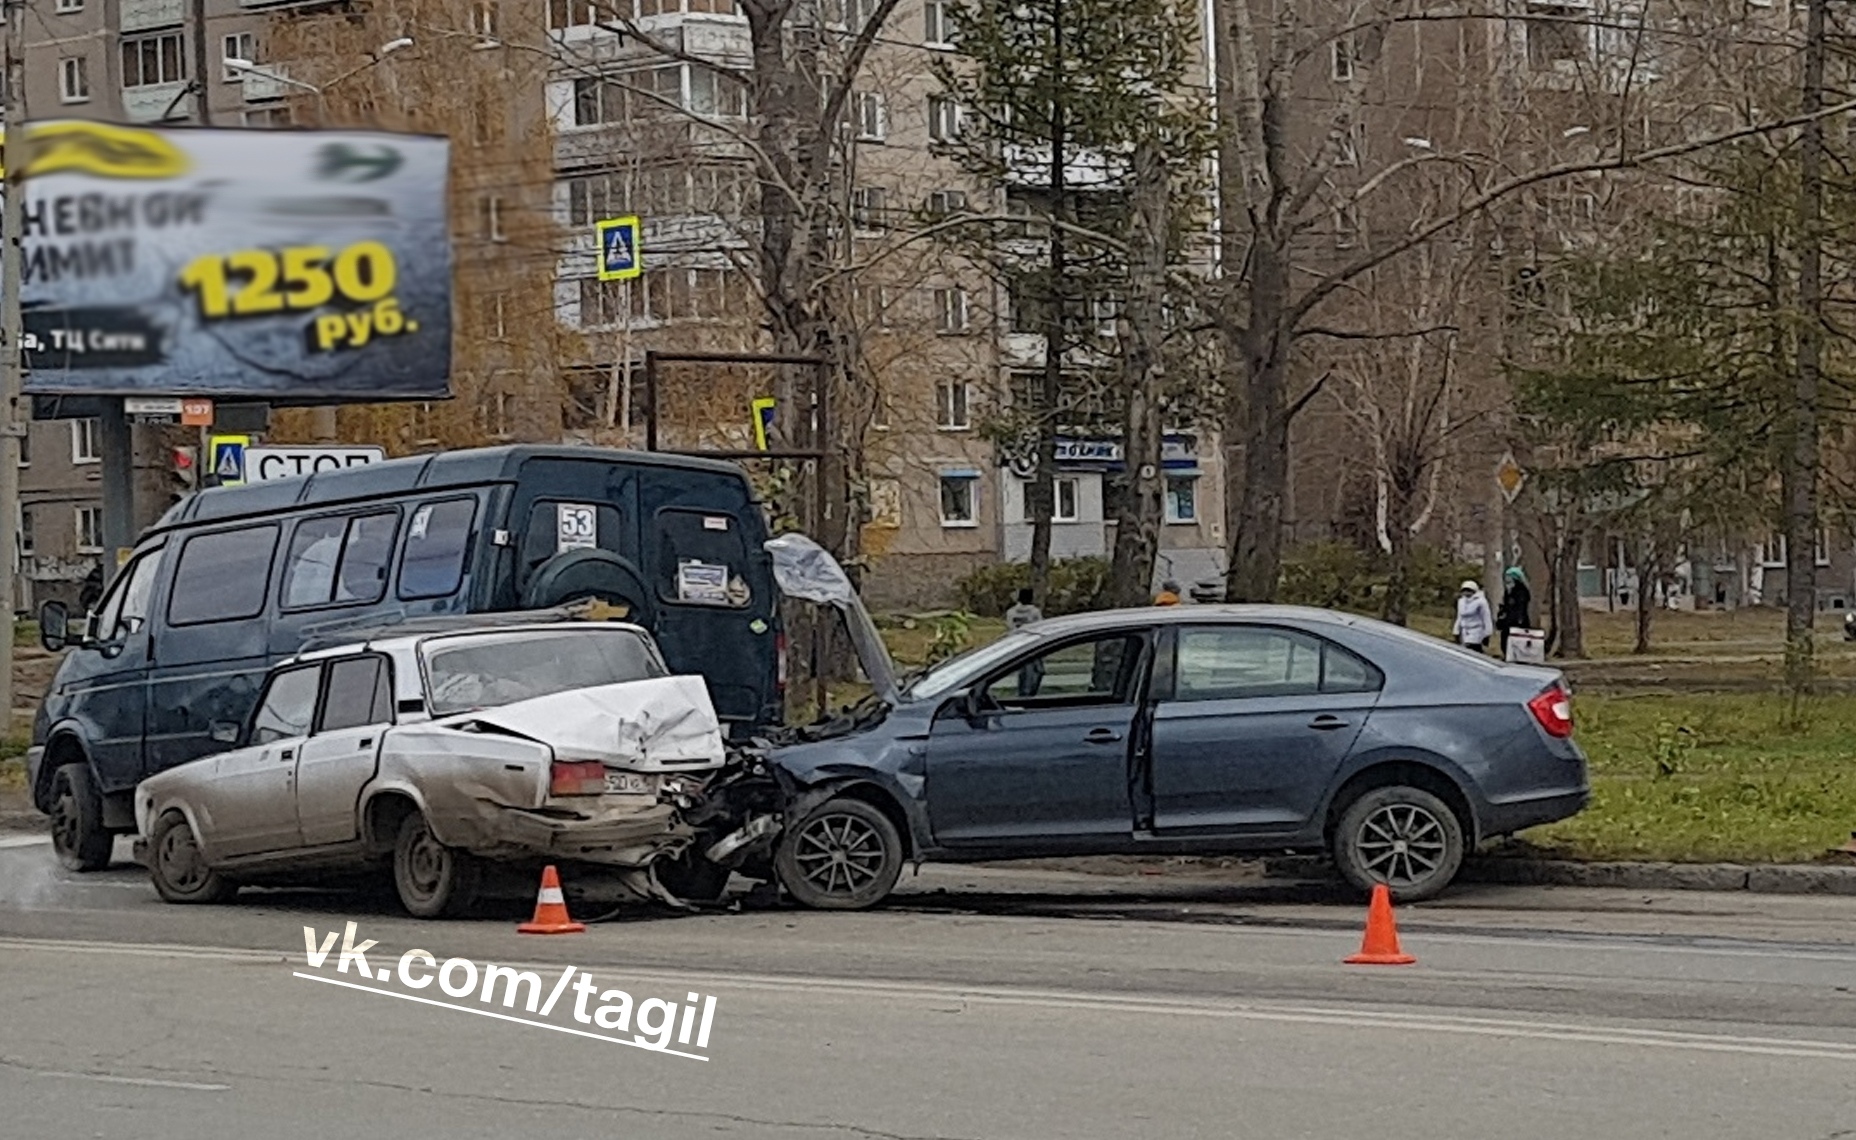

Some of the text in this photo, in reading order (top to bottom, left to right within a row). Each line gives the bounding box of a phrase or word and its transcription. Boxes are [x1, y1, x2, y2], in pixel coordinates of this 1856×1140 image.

[180, 240, 396, 316] 1250
[50, 329, 85, 353] ТЦ
[316, 297, 418, 350] руб.
[562, 509, 593, 536] 53
